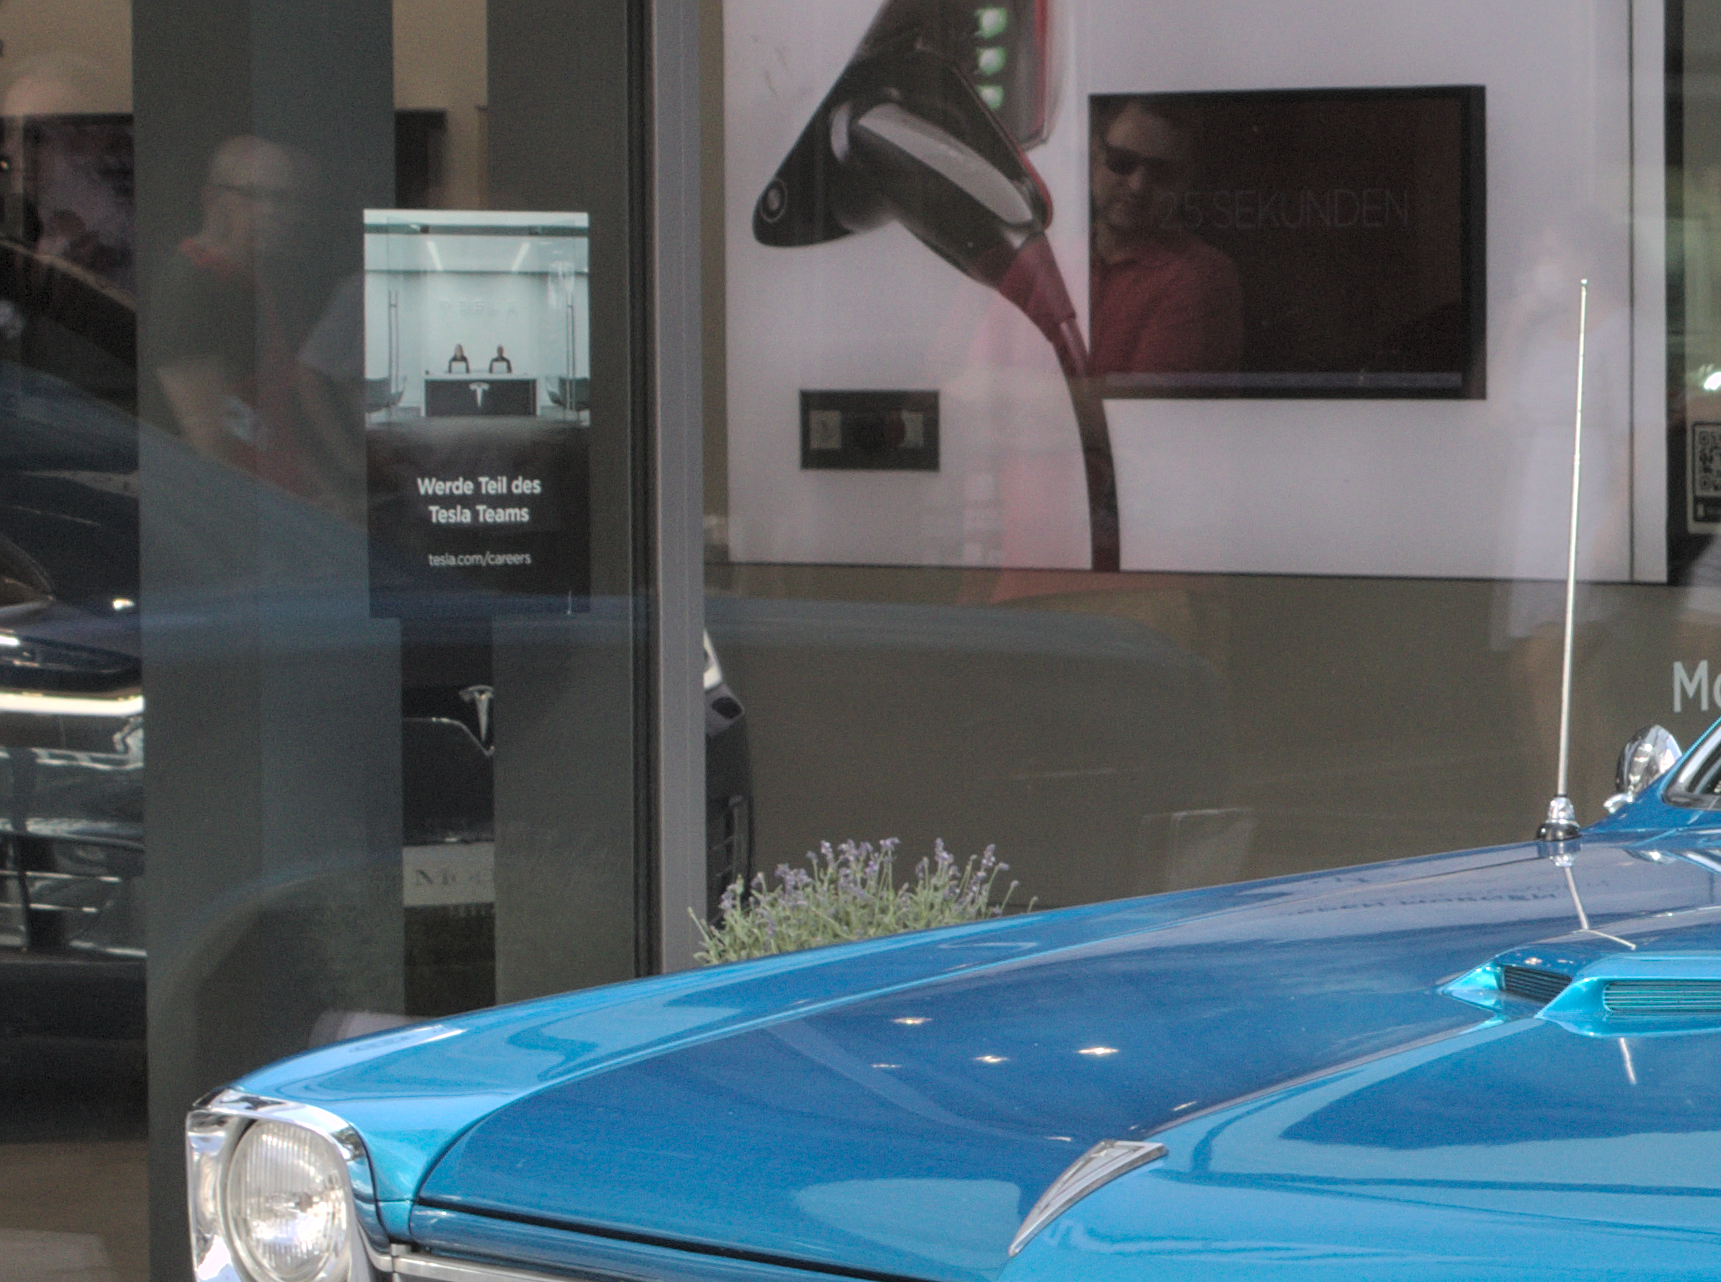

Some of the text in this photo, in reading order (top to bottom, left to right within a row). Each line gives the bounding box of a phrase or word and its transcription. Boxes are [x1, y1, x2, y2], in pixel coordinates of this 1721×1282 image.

[417, 476, 542, 495] Werde Teil des
[428, 505, 530, 523] Tesla Teams
[428, 551, 532, 567] tesla.com/careers
